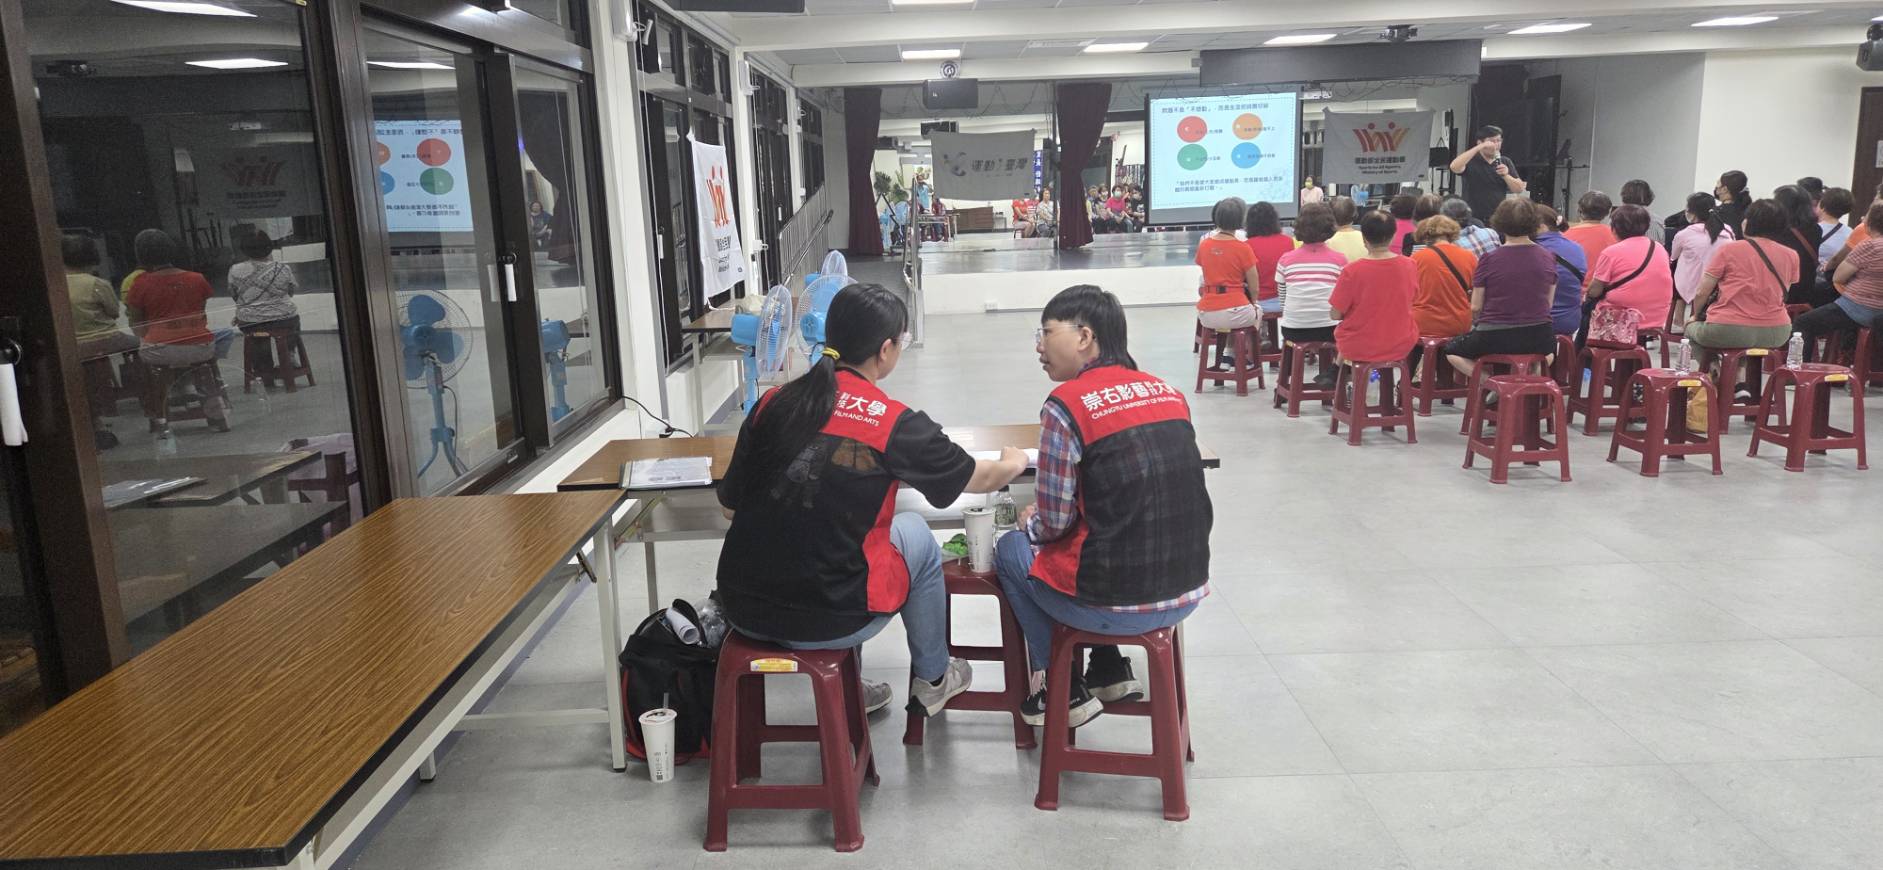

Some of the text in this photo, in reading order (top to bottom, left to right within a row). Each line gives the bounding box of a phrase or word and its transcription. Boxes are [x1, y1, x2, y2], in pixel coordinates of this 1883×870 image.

[1091, 405, 1123, 419] CHUNGYU
[1123, 399, 1151, 410] UNIVERSITY
[848, 412, 864, 421] AND
[863, 417, 880, 426] ARTS
